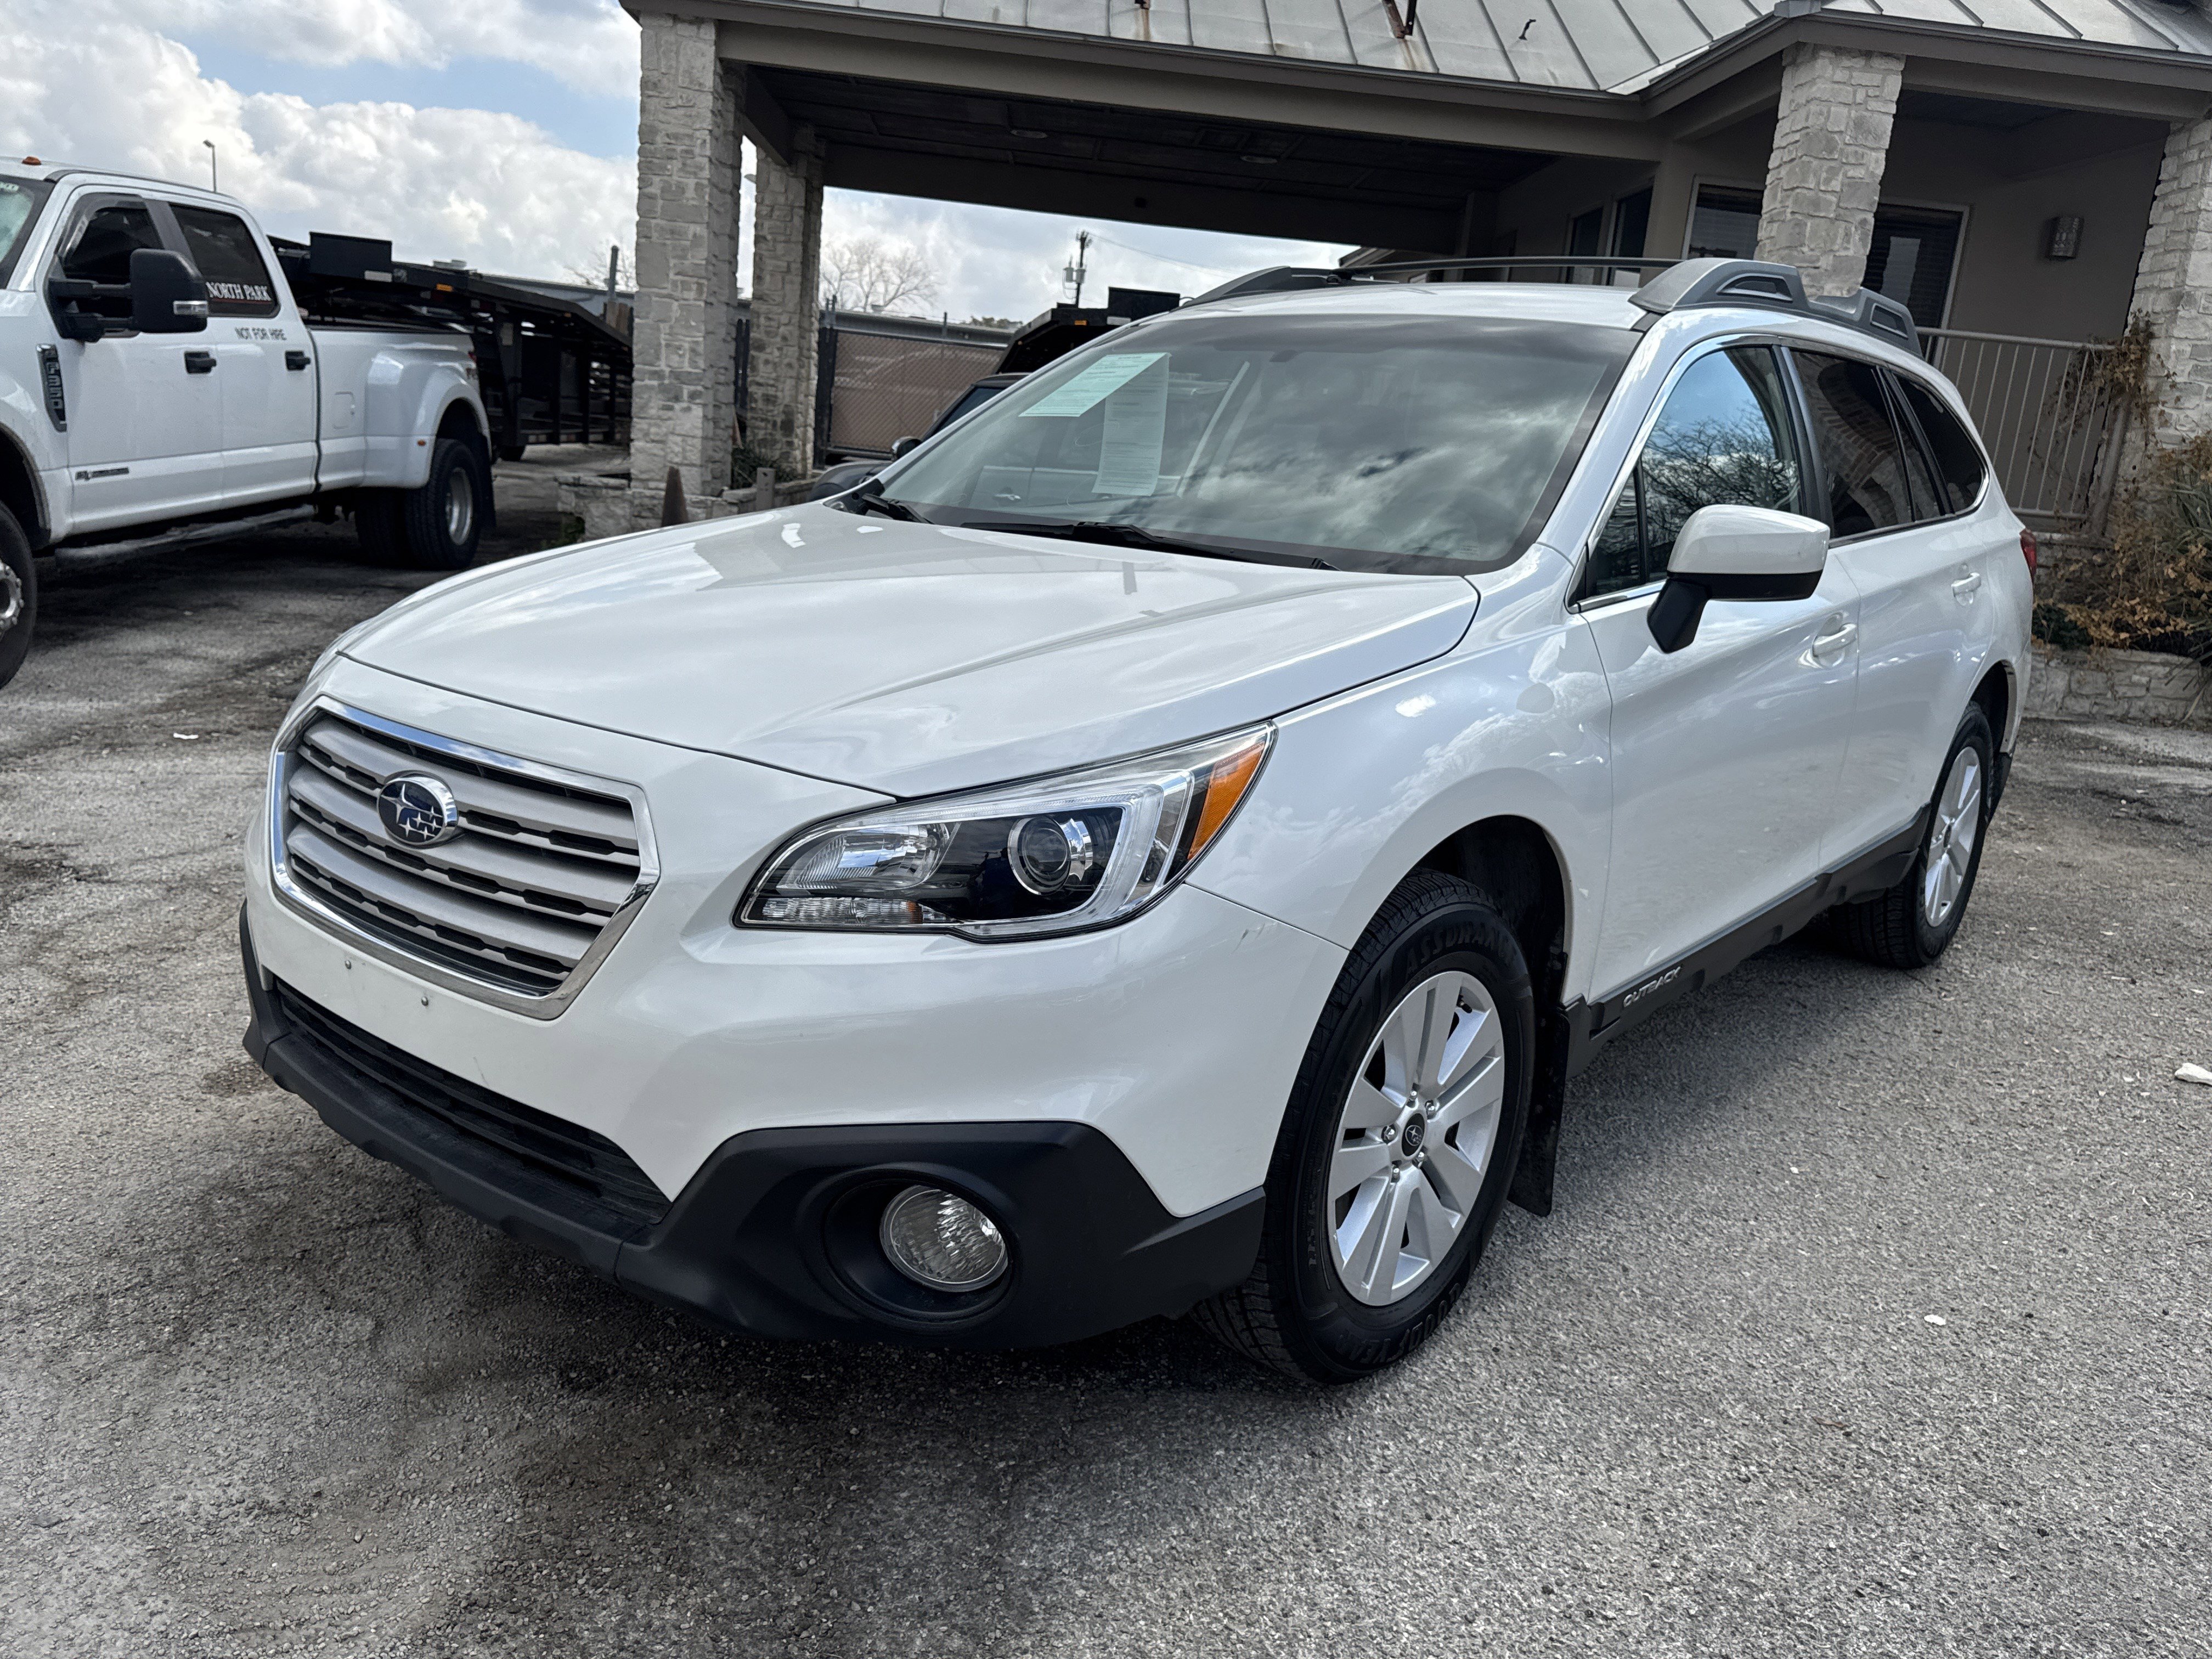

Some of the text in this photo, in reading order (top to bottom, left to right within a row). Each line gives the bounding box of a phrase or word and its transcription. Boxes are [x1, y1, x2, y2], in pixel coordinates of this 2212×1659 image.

[206, 281, 272, 301] NORTH PARK
[234, 327, 252, 340] NOT
[252, 328, 270, 340] FOR
[1624, 966, 1680, 1007] OUTBACK
